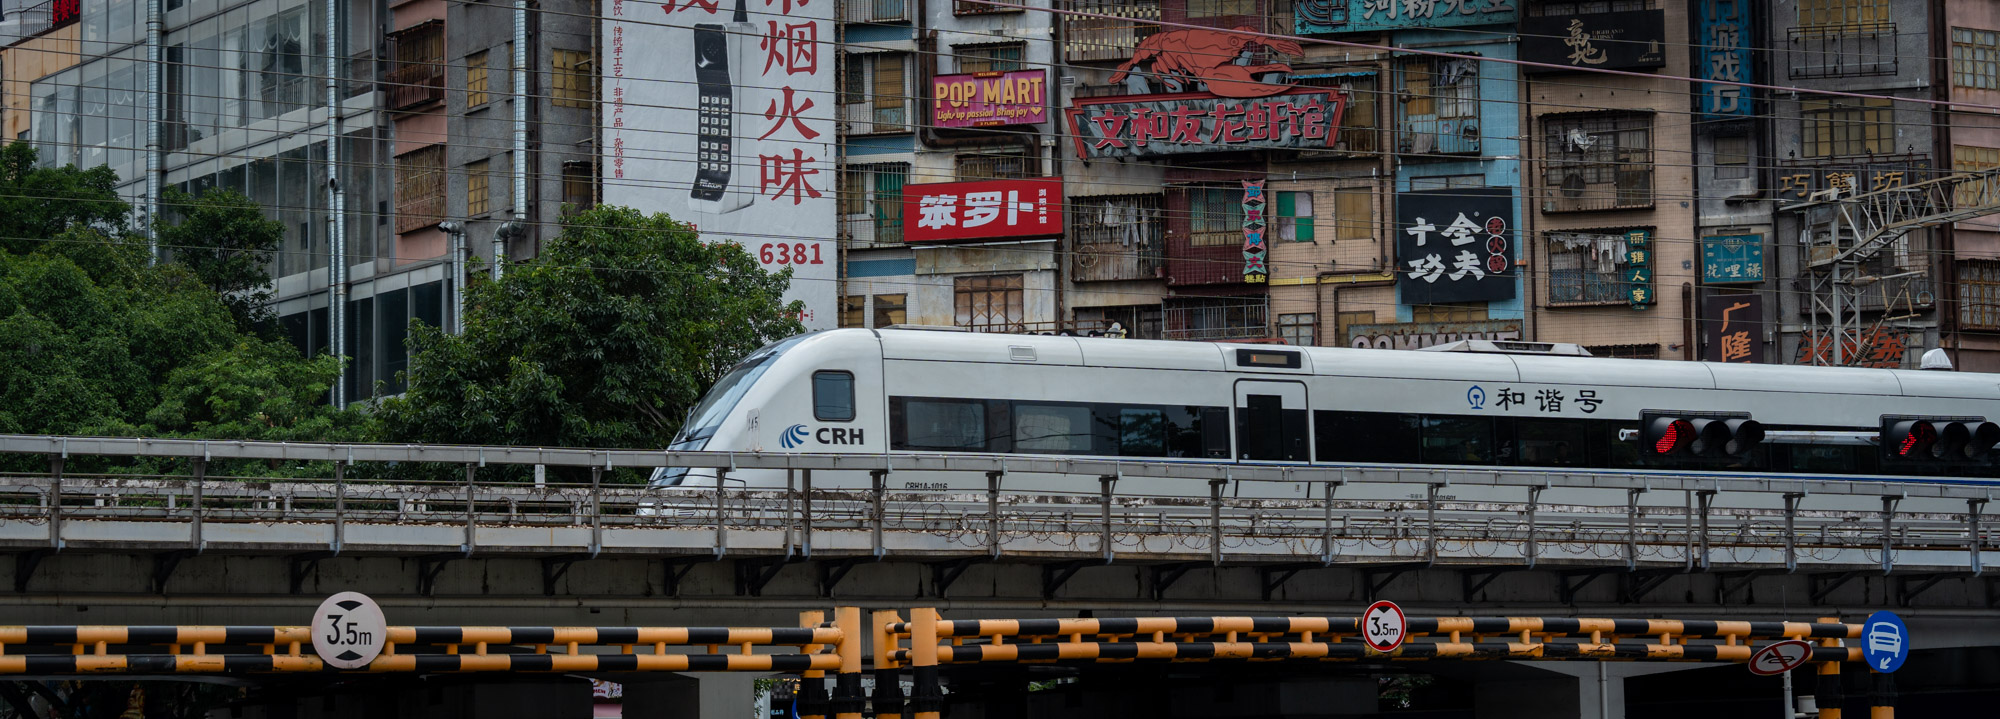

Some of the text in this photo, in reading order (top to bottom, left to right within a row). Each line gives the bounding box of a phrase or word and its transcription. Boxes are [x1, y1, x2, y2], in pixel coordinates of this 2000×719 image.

[757, 0, 823, 206] 烟火味
[935, 77, 1043, 109] POP MART
[956, 112, 965, 120] up
[966, 109, 994, 120] passion
[996, 108, 1015, 118] Bring
[1016, 107, 1028, 118] joy
[1091, 99, 1325, 149] 文和友龙虾馆
[918, 189, 1034, 230] 笨罗卜
[1405, 212, 1484, 247] 十全
[760, 243, 824, 265] 6381
[1408, 250, 1485, 283] 功夫
[1630, 232, 1646, 303] 丽雅人家
[1721, 302, 1752, 363] 广隆
[1495, 387, 1604, 414] 和谐号
[815, 427, 864, 445] CRH
[327, 614, 372, 646] 3.5m
[1371, 616, 1399, 637] 3.5m
